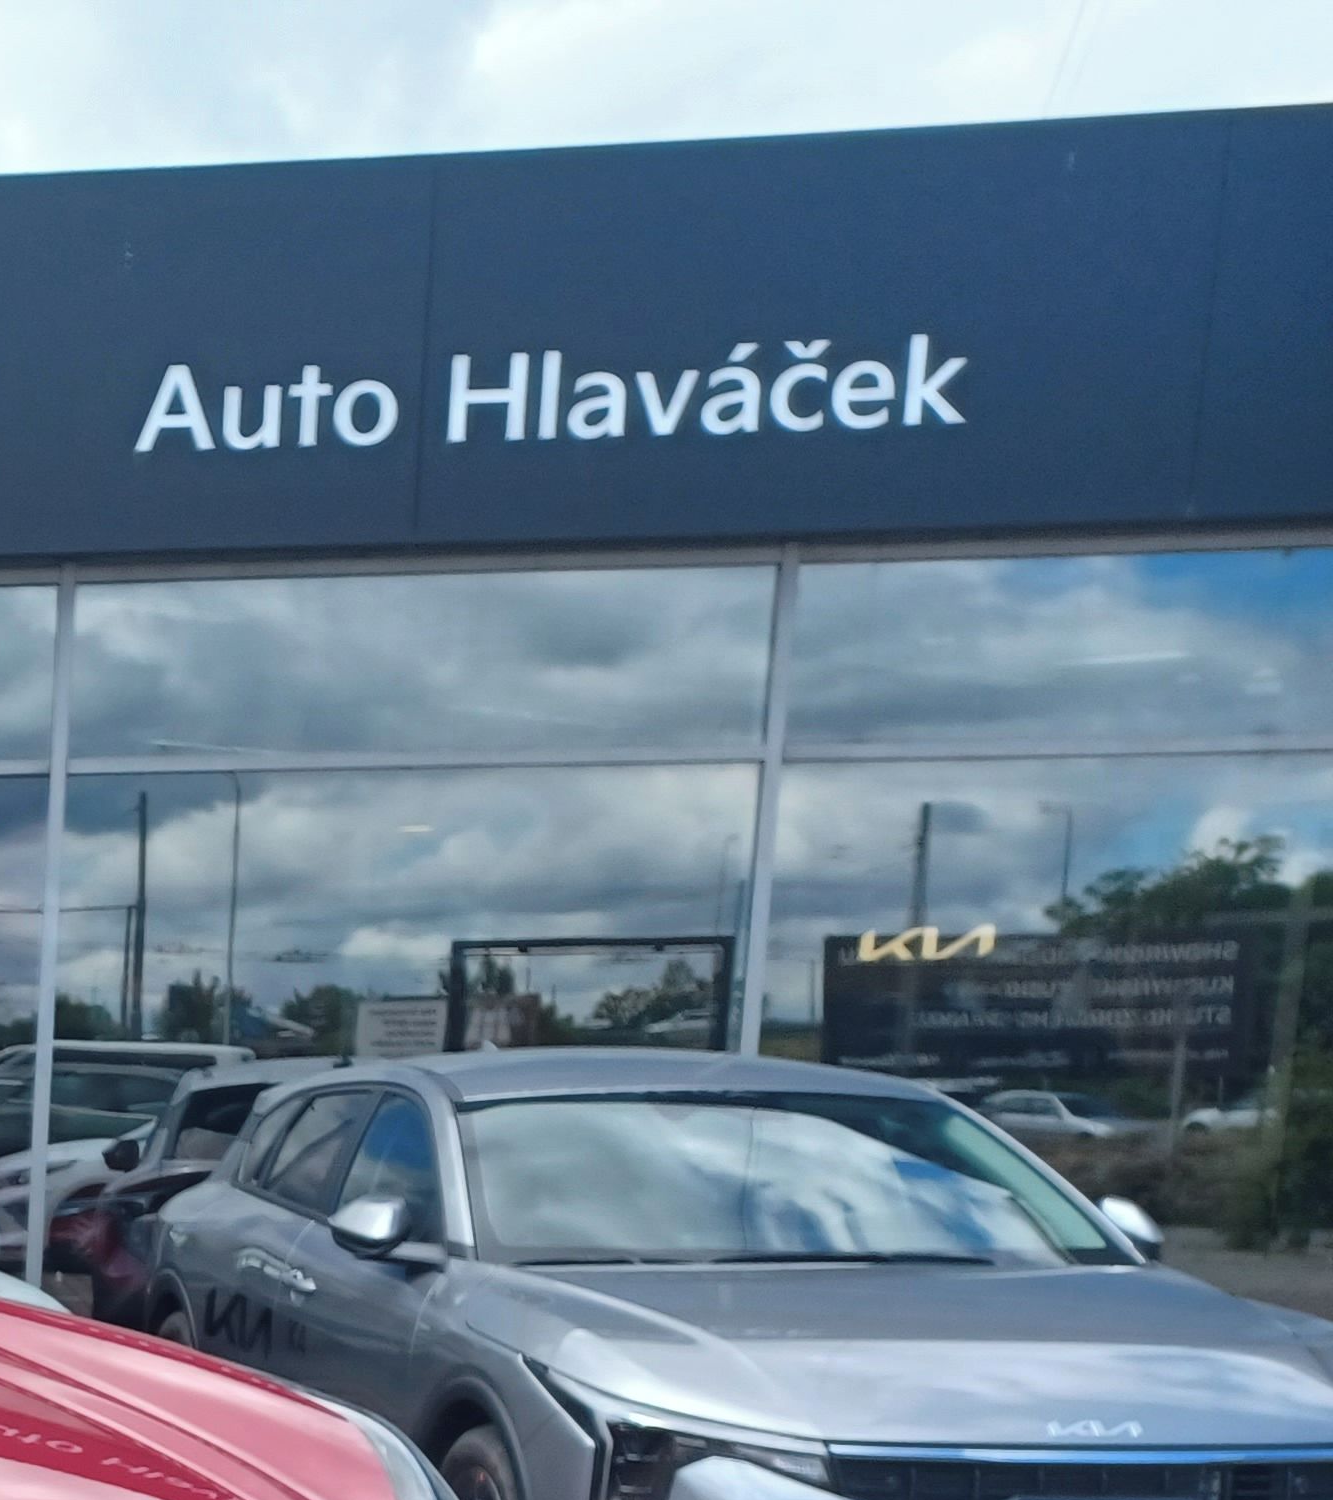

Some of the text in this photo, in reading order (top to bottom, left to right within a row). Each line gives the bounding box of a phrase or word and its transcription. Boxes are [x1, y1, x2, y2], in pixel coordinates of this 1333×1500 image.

[134, 333, 969, 452] Auto Hlaváček
[857, 922, 997, 962] KIA
